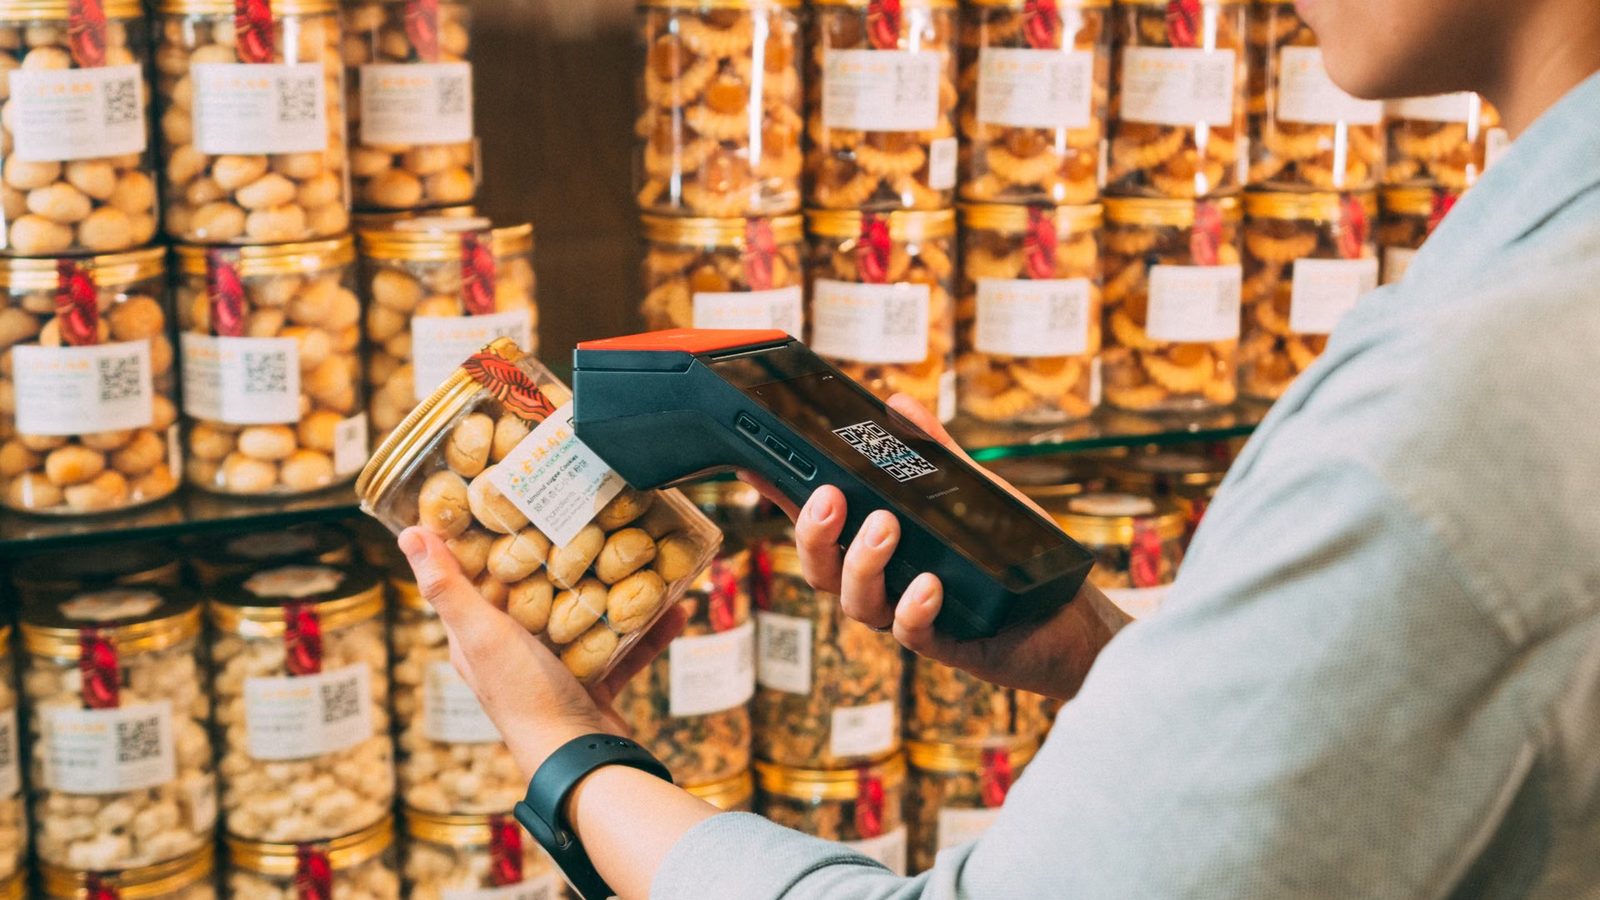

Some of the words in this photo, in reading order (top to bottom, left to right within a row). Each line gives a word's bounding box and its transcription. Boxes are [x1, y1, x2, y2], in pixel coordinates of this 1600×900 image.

[525, 483, 547, 505] Almond
[545, 470, 562, 487] sugee
[558, 452, 578, 472] Cookies
